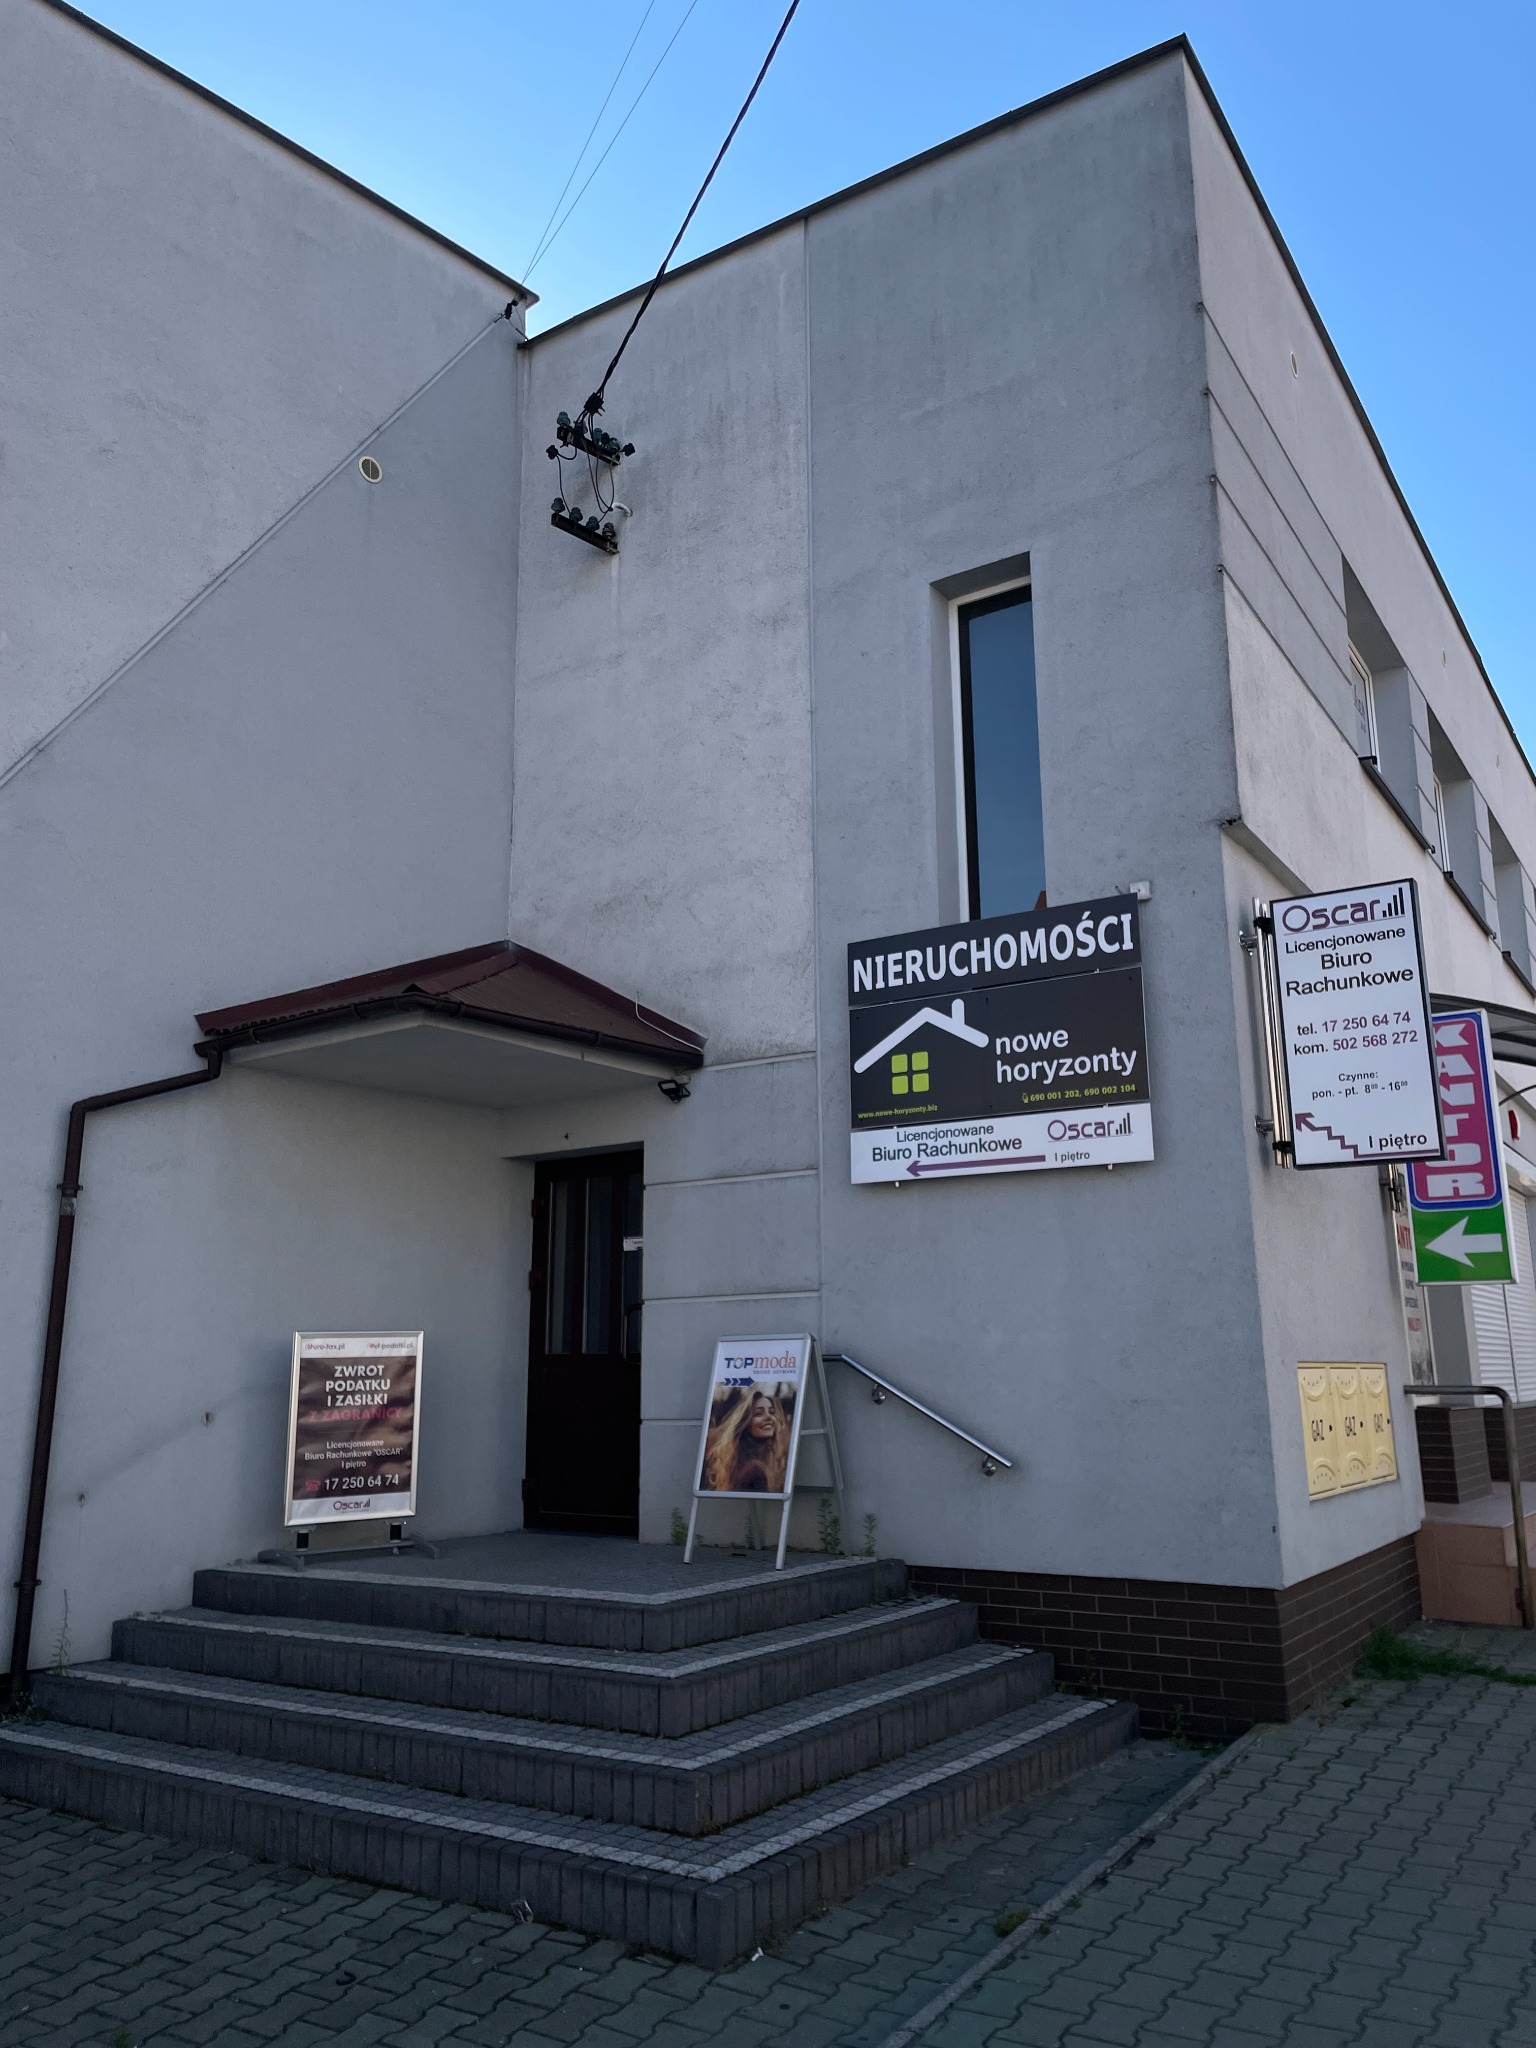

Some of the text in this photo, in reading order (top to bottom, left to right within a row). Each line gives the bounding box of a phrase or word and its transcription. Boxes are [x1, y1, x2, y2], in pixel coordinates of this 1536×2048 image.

[1282, 899, 1382, 933] Oscar
[1285, 926, 1406, 954] Licencjonowane
[853, 911, 1134, 992] NIERUCHOMOŚCI
[1321, 951, 1372, 970] Biuro
[1286, 968, 1414, 997] Rachunkowe
[1297, 1011, 1411, 1036] tel. 17 250 64 74
[995, 1030, 1069, 1055] nowe
[1294, 1030, 1418, 1055] kom. 502 568 272
[997, 1048, 1136, 1084] horyzonty
[1338, 1070, 1378, 1084] Czynne:
[1030, 1085, 1135, 1102] 690 001 202, 690 002 104
[1312, 1088, 1336, 1101] pon.
[1345, 1085, 1359, 1097] pt.
[858, 1104, 937, 1119] www.nowe-horyzonty.biz
[896, 1123, 994, 1143] Licencjonowane
[1048, 1119, 1114, 1140] Oscar
[872, 1135, 1022, 1162] Biuro Rachunkowe
[1379, 1132, 1428, 1152] piętro
[1061, 1150, 1090, 1164] piętro
[334, 1365, 384, 1378] ZWROT
[326, 1379, 390, 1392] PODATKU
[327, 1394, 387, 1407] I ZASIŁKI
[322, 1407, 403, 1421] ZAGRANICY
[327, 1439, 384, 1450] Licencjonowane
[305, 1452, 324, 1460] Biuro
[326, 1450, 372, 1459] Rachunkowe
[346, 1460, 366, 1470] piętro
[325, 1474, 399, 1490] 17 250 64 74
[333, 1501, 364, 1510] Oscar
